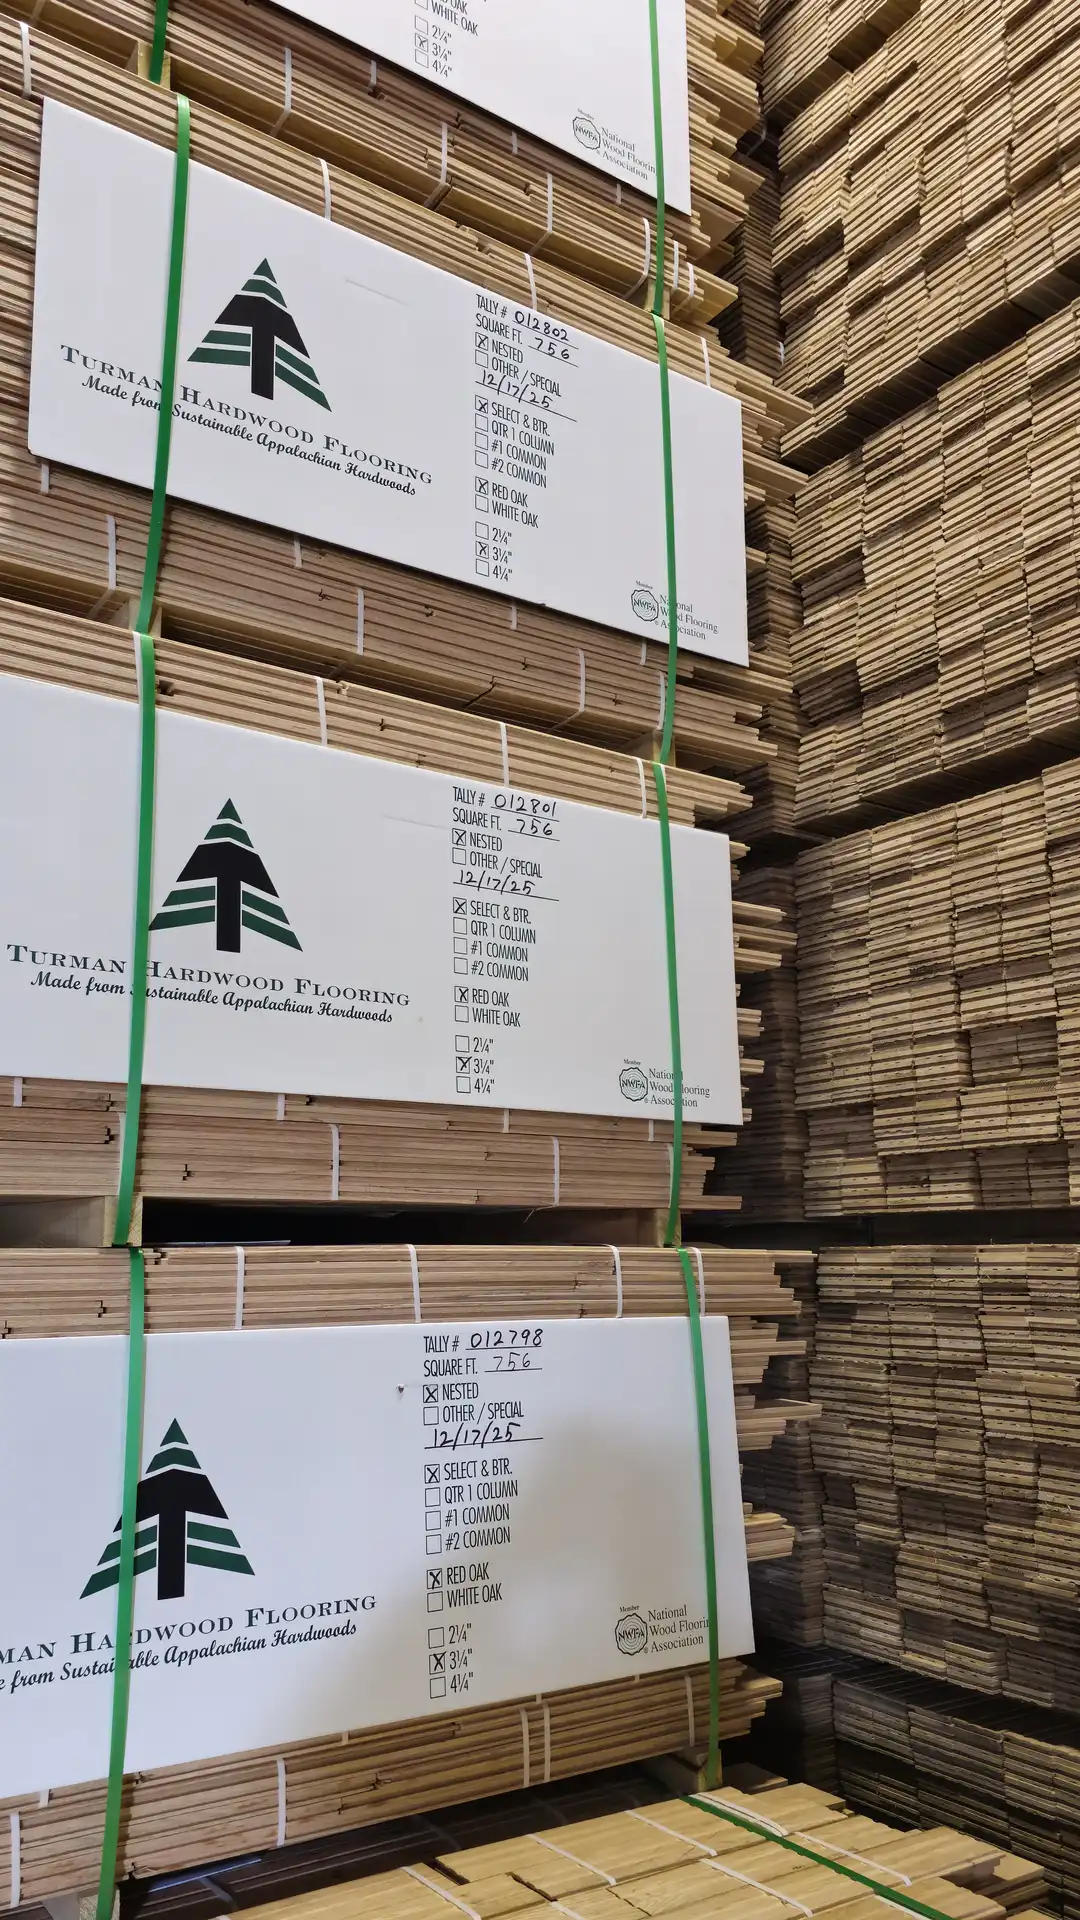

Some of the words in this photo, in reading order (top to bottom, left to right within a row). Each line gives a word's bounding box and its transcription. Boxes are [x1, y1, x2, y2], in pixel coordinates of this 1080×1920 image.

[431, 0, 458, 26] WHITE
[461, 17, 478, 36] OAK
[576, 125, 598, 142] NWFA
[602, 127, 635, 152] National
[602, 139, 625, 158] Wood
[627, 152, 656, 174] Floorin
[603, 151, 648, 180] Association
[476, 294, 498, 315] TALLY
[501, 305, 508, 319] #
[514, 310, 569, 342] 012802
[476, 313, 509, 339] SQUARE
[512, 328, 523, 345] FT.
[535, 337, 570, 360] 756
[492, 339, 523, 363] NESTED
[482, 370, 553, 409] 12/17/25
[492, 357, 519, 380] OTHER
[530, 372, 561, 397] SPECIAL
[492, 402, 520, 425] SELECT
[523, 414, 530, 429] &
[533, 417, 550, 437] BTR.
[82, 375, 128, 400] Made
[172, 404, 253, 441] Sustainable
[256, 432, 341, 471] Appalachian
[344, 462, 416, 495] Hardwoods
[180, 385, 314, 444] HARDWOOD
[323, 435, 432, 484] FLOORING
[492, 420, 508, 438] QTR
[520, 430, 554, 456] COLUMN
[491, 439, 503, 454] #1
[506, 443, 547, 471] COMMON
[491, 457, 504, 473] #2
[506, 462, 547, 488] COMMON
[492, 482, 508, 500] RED
[511, 489, 528, 507] OAK
[492, 499, 519, 522] WHITE
[521, 510, 539, 528] OAK
[633, 599, 656, 612] NWFA
[685, 614, 719, 634] Flooring
[453, 786, 476, 805] TALLY
[478, 793, 485, 807] #
[494, 794, 556, 817] 012801
[453, 807, 488, 829] SQUARE
[491, 814, 501, 831] FT.
[516, 818, 553, 836] 756
[470, 832, 502, 852] NESTED
[470, 851, 498, 870] OTHER
[510, 858, 543, 878] SPECIAL
[460, 869, 536, 895] 12/17/25
[470, 900, 500, 919] SELECT
[503, 905, 510, 921] &
[513, 907, 531, 924] BTR.
[471, 920, 488, 937] QTR
[499, 924, 536, 944] COLUMN
[471, 940, 482, 956] #1
[486, 942, 528, 962] COMMON
[7, 944, 127, 974] TURMAN
[293, 978, 410, 1007] FLOORING
[471, 960, 484, 976] #2
[487, 962, 529, 981] COMMON
[31, 971, 81, 990] Made
[86, 976, 125, 996] from
[223, 991, 313, 1014] Appalachian
[317, 1002, 393, 1023] Hardwoods
[472, 988, 489, 1004] RED
[491, 990, 510, 1007] OAK
[472, 1006, 501, 1025] WHITE
[503, 1011, 521, 1027] OAK
[622, 1079, 646, 1089] NWFA
[649, 1081, 673, 1093] Wood
[682, 1084, 710, 1098] looring
[650, 1095, 698, 1107] Assoction
[423, 1335, 449, 1353] TALLY
[452, 1335, 459, 1352] #
[470, 1328, 543, 1348] 012798
[424, 1358, 462, 1377] SQUARE
[466, 1358, 478, 1374] FT.
[493, 1352, 531, 1371] 756
[442, 1382, 479, 1400] NESTED
[442, 1404, 475, 1423] OTHER
[488, 1401, 524, 1420] SPECIAL
[434, 1420, 521, 1451] 12/17/25
[444, 1460, 478, 1481] SELECT
[481, 1459, 489, 1477] &
[492, 1458, 513, 1476] BTR.
[445, 1485, 464, 1504] QTR
[477, 1480, 518, 1500] COLUMN
[445, 1509, 458, 1527] #1
[462, 1503, 510, 1525] COMMON
[445, 1532, 460, 1551] #2
[463, 1526, 511, 1548] COMMON
[447, 1566, 466, 1585] RED
[469, 1562, 490, 1581] OAK
[447, 1586, 479, 1608] WHITE
[482, 1582, 503, 1603] OAK
[648, 1604, 687, 1621] National
[0, 1642, 57, 1665] MAN
[70, 1616, 233, 1654] HADWOOD
[245, 1595, 377, 1628] FLOORING
[618, 1628, 645, 1641] NWFA
[649, 1621, 676, 1636] Wood
[679, 1617, 709, 1632] Floori
[651, 1634, 704, 1653] Association
[10, 1669, 55, 1694] from
[60, 1650, 159, 1681] Sustaiable
[164, 1636, 267, 1668] Appalachian
[271, 1619, 357, 1647] Hardwoods
